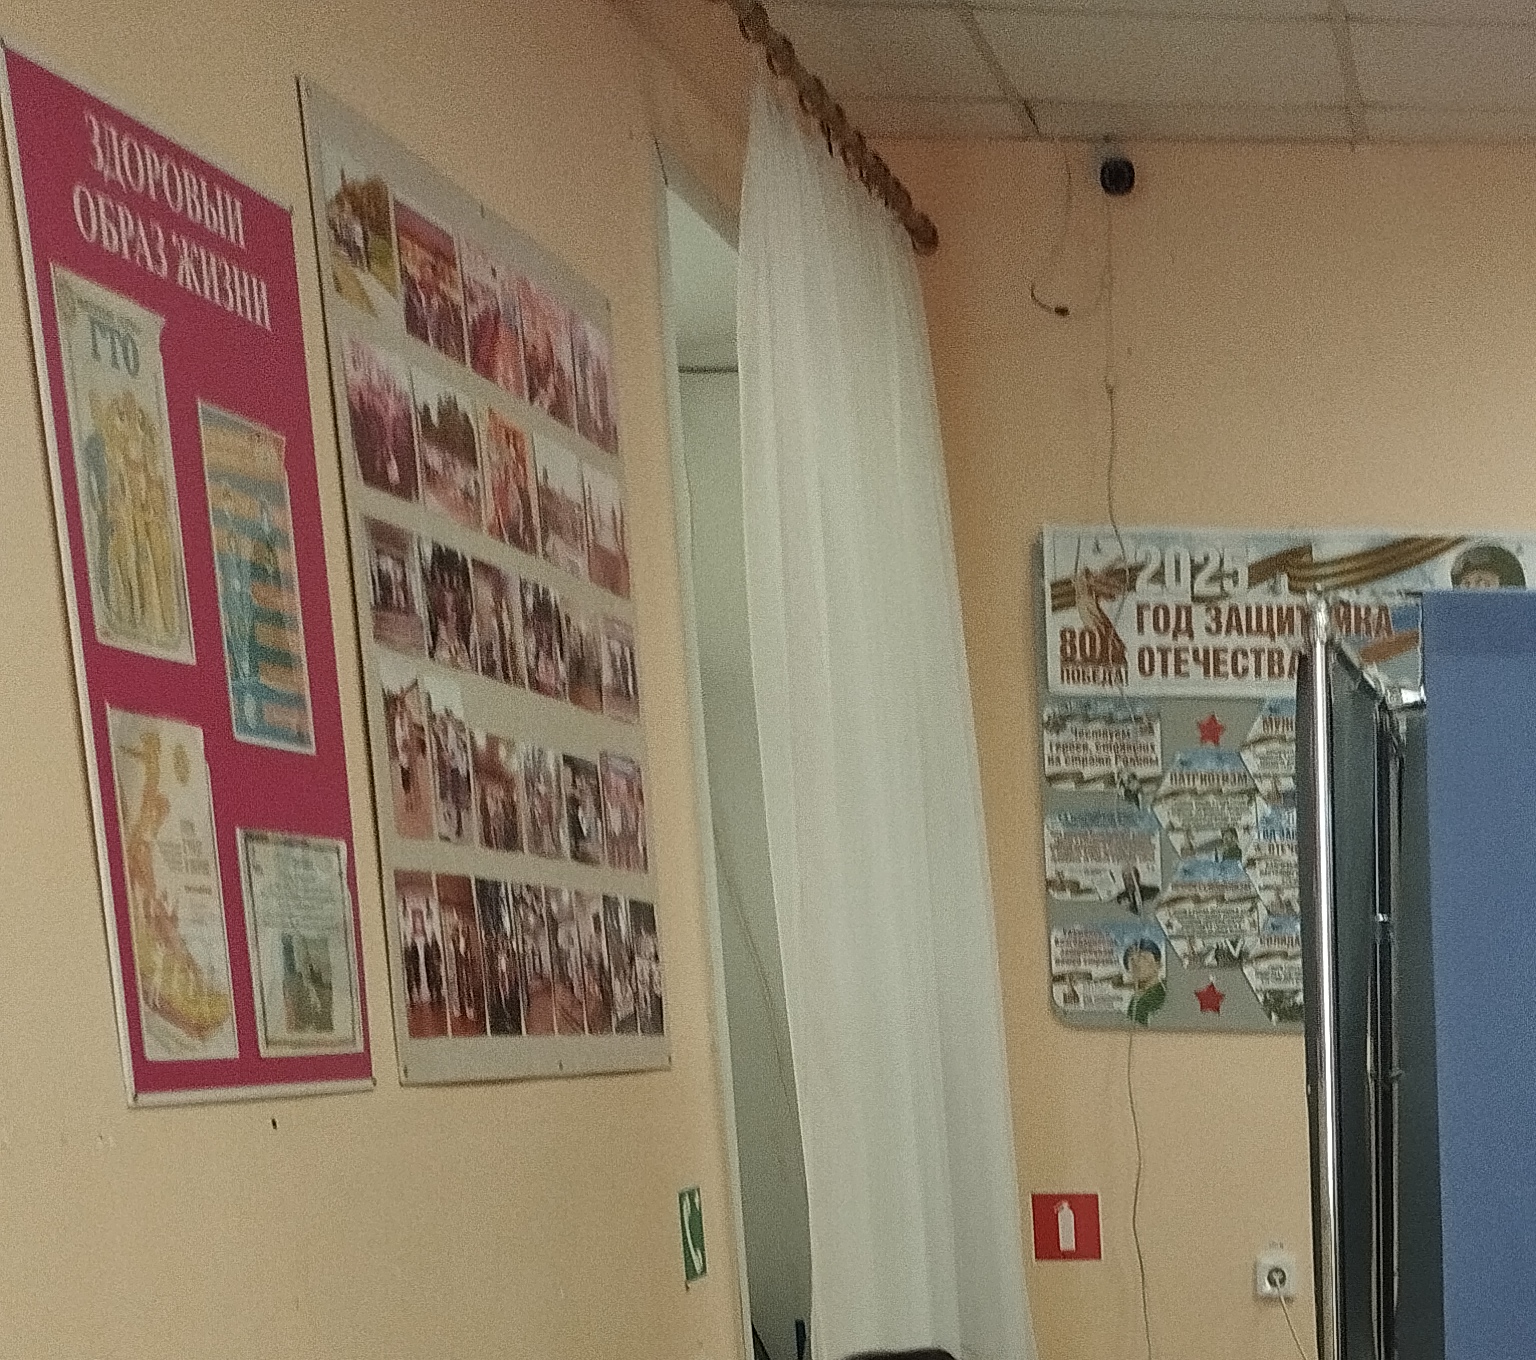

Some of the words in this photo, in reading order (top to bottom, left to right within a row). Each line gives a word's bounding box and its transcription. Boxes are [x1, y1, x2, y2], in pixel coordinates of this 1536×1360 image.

[84, 107, 247, 251] ЗДОРОВЫЙ
[72, 184, 168, 281] ОБРАЗ
[172, 232, 273, 333] ЖИЗНИ
[1135, 548, 1248, 599] 2025
[1136, 603, 1195, 642] ГОД
